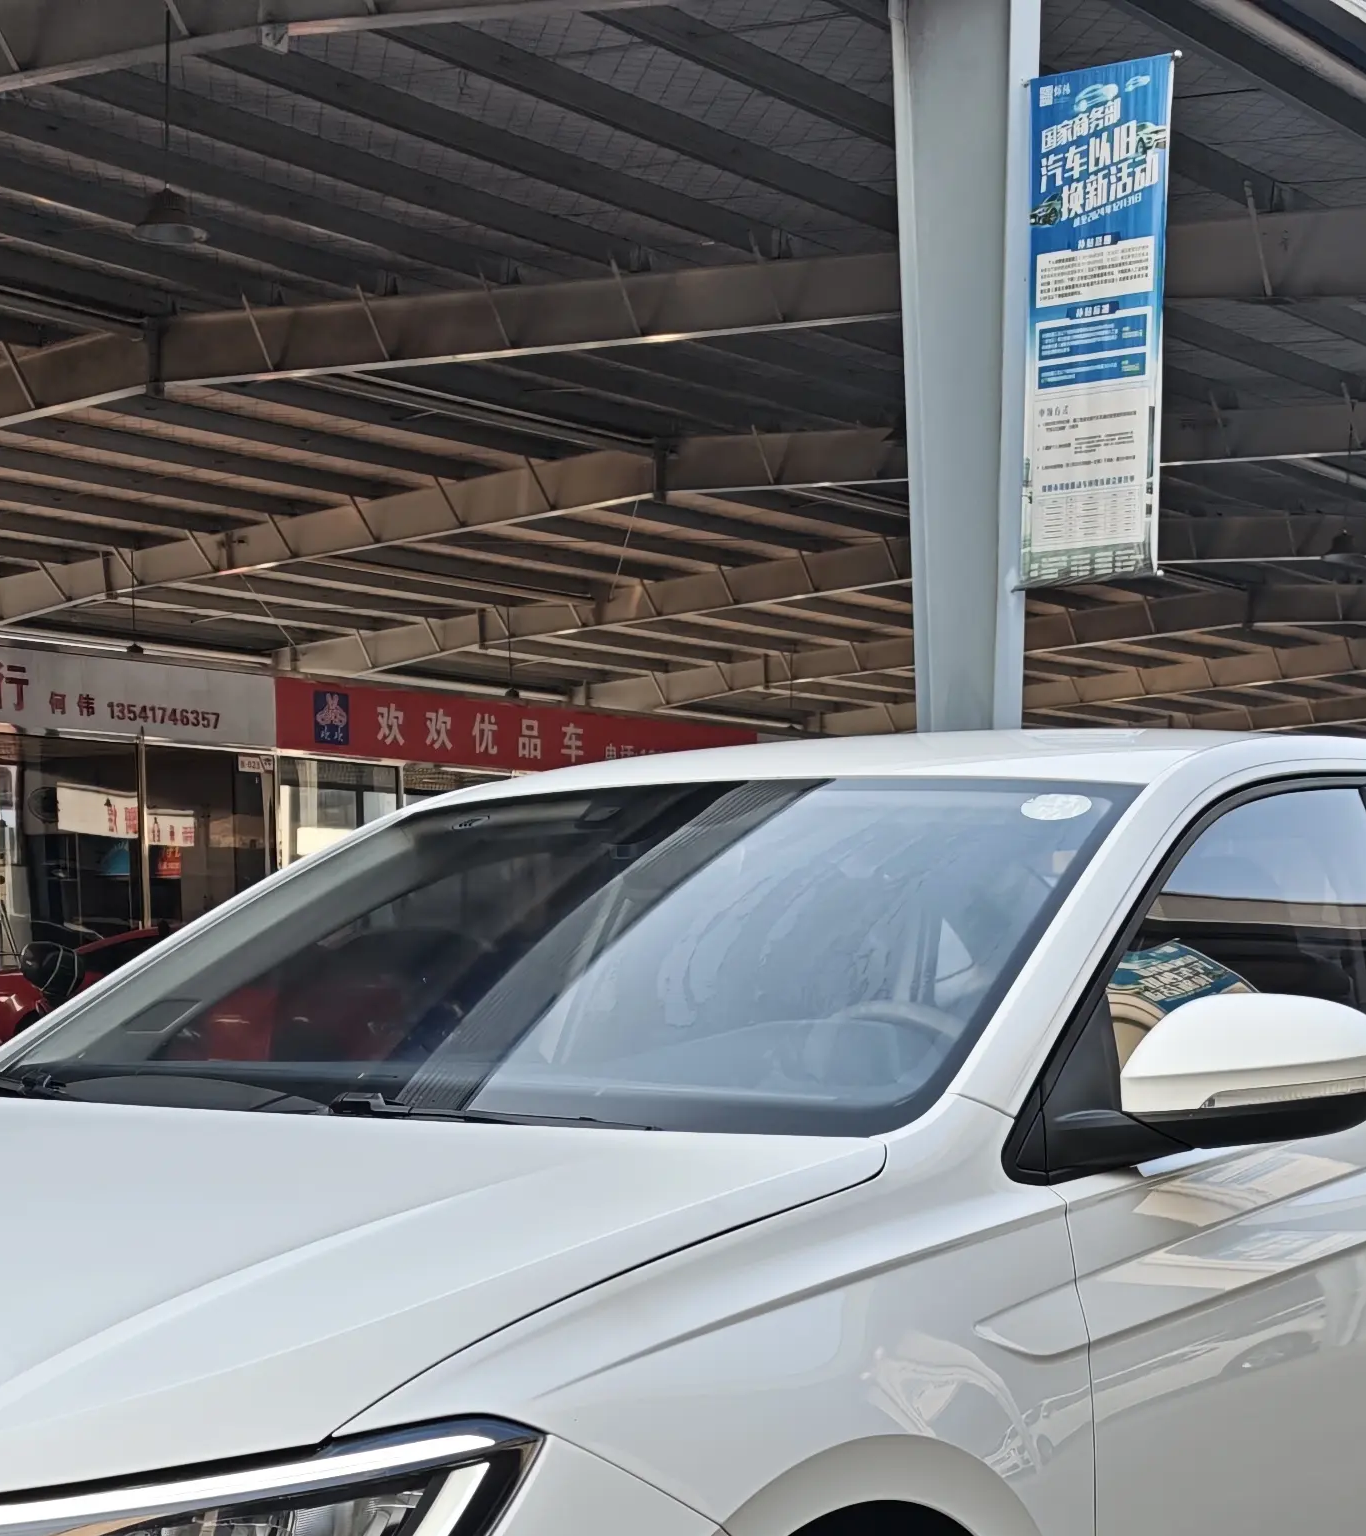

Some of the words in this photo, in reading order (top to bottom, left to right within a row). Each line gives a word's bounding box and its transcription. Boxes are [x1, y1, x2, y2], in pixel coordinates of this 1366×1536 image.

[1041, 98, 1121, 153] 国家商务部
[1040, 120, 1137, 194] 汽车以旧
[1060, 149, 1159, 222] 换新活动
[49, 691, 96, 717] 何伟
[107, 700, 221, 730] 13541746357
[376, 702, 585, 764] 欢欢优品车
